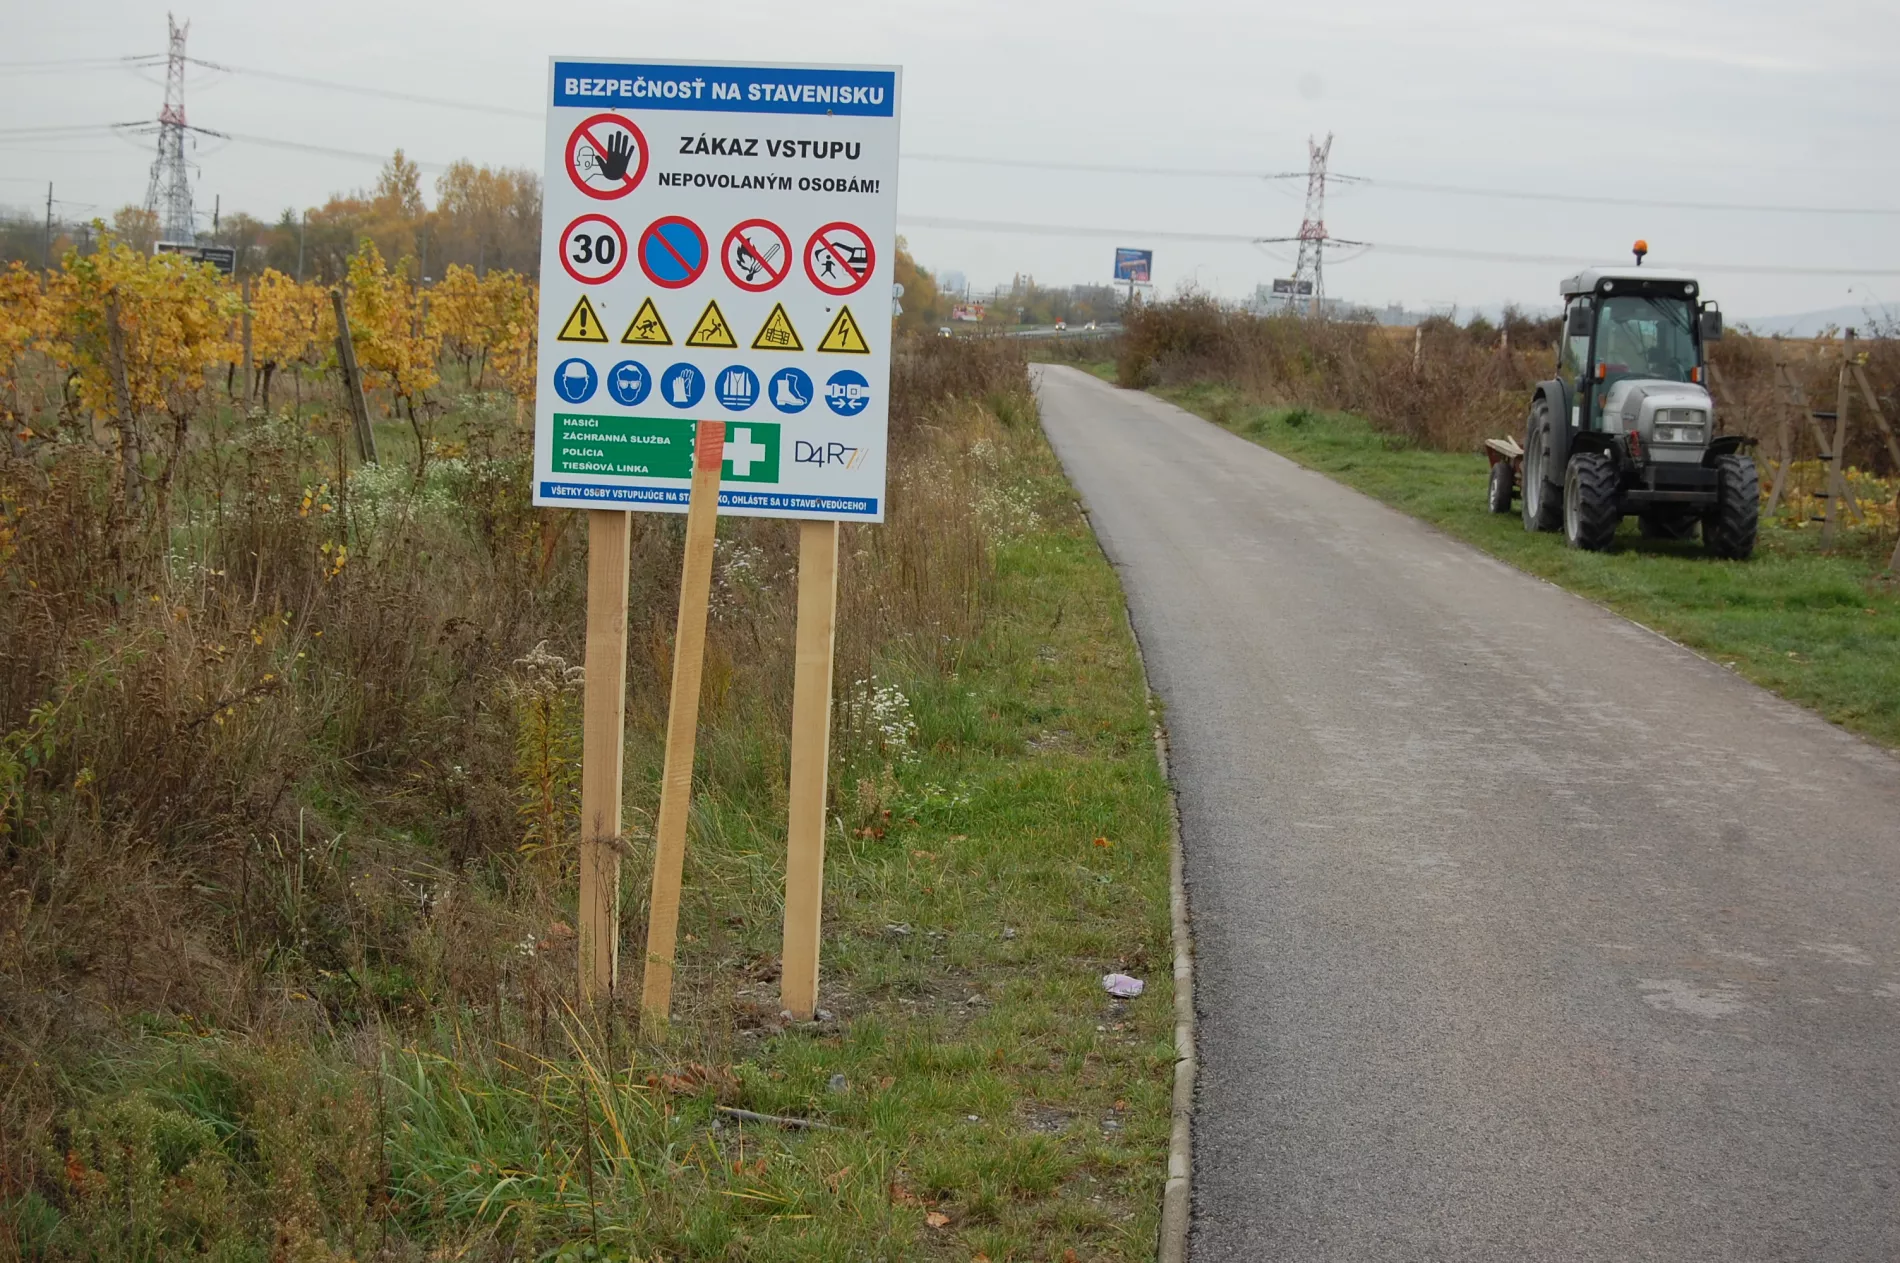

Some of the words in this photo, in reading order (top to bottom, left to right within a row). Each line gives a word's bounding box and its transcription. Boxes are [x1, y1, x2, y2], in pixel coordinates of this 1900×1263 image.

[565, 76, 705, 99] BEZPEČNOSŤ
[712, 83, 741, 100] NA
[748, 83, 884, 105] STAVENISKU
[679, 133, 758, 157] ZÁKAZ
[766, 139, 861, 160] VSTUPU
[658, 172, 792, 191] NEPOVOLANÝM
[798, 174, 880, 193] OSOBÁM!
[572, 233, 615, 264] 30
[563, 418, 599, 427] HASIČI
[562, 432, 627, 443] ZÁCHRANNÁ
[630, 435, 671, 445] SLUŽBA
[562, 447, 604, 457] POLÍCIA
[562, 461, 614, 472] TIESŇOVÁ
[616, 464, 649, 473] LINKA
[551, 485, 582, 496] VŠETKY
[613, 489, 664, 500] VSTUPUJÚCE
[665, 491, 677, 501] NA
[731, 494, 768, 506] OHLÁSTE
[770, 497, 781, 507] SA
[782, 497, 789, 506] U
